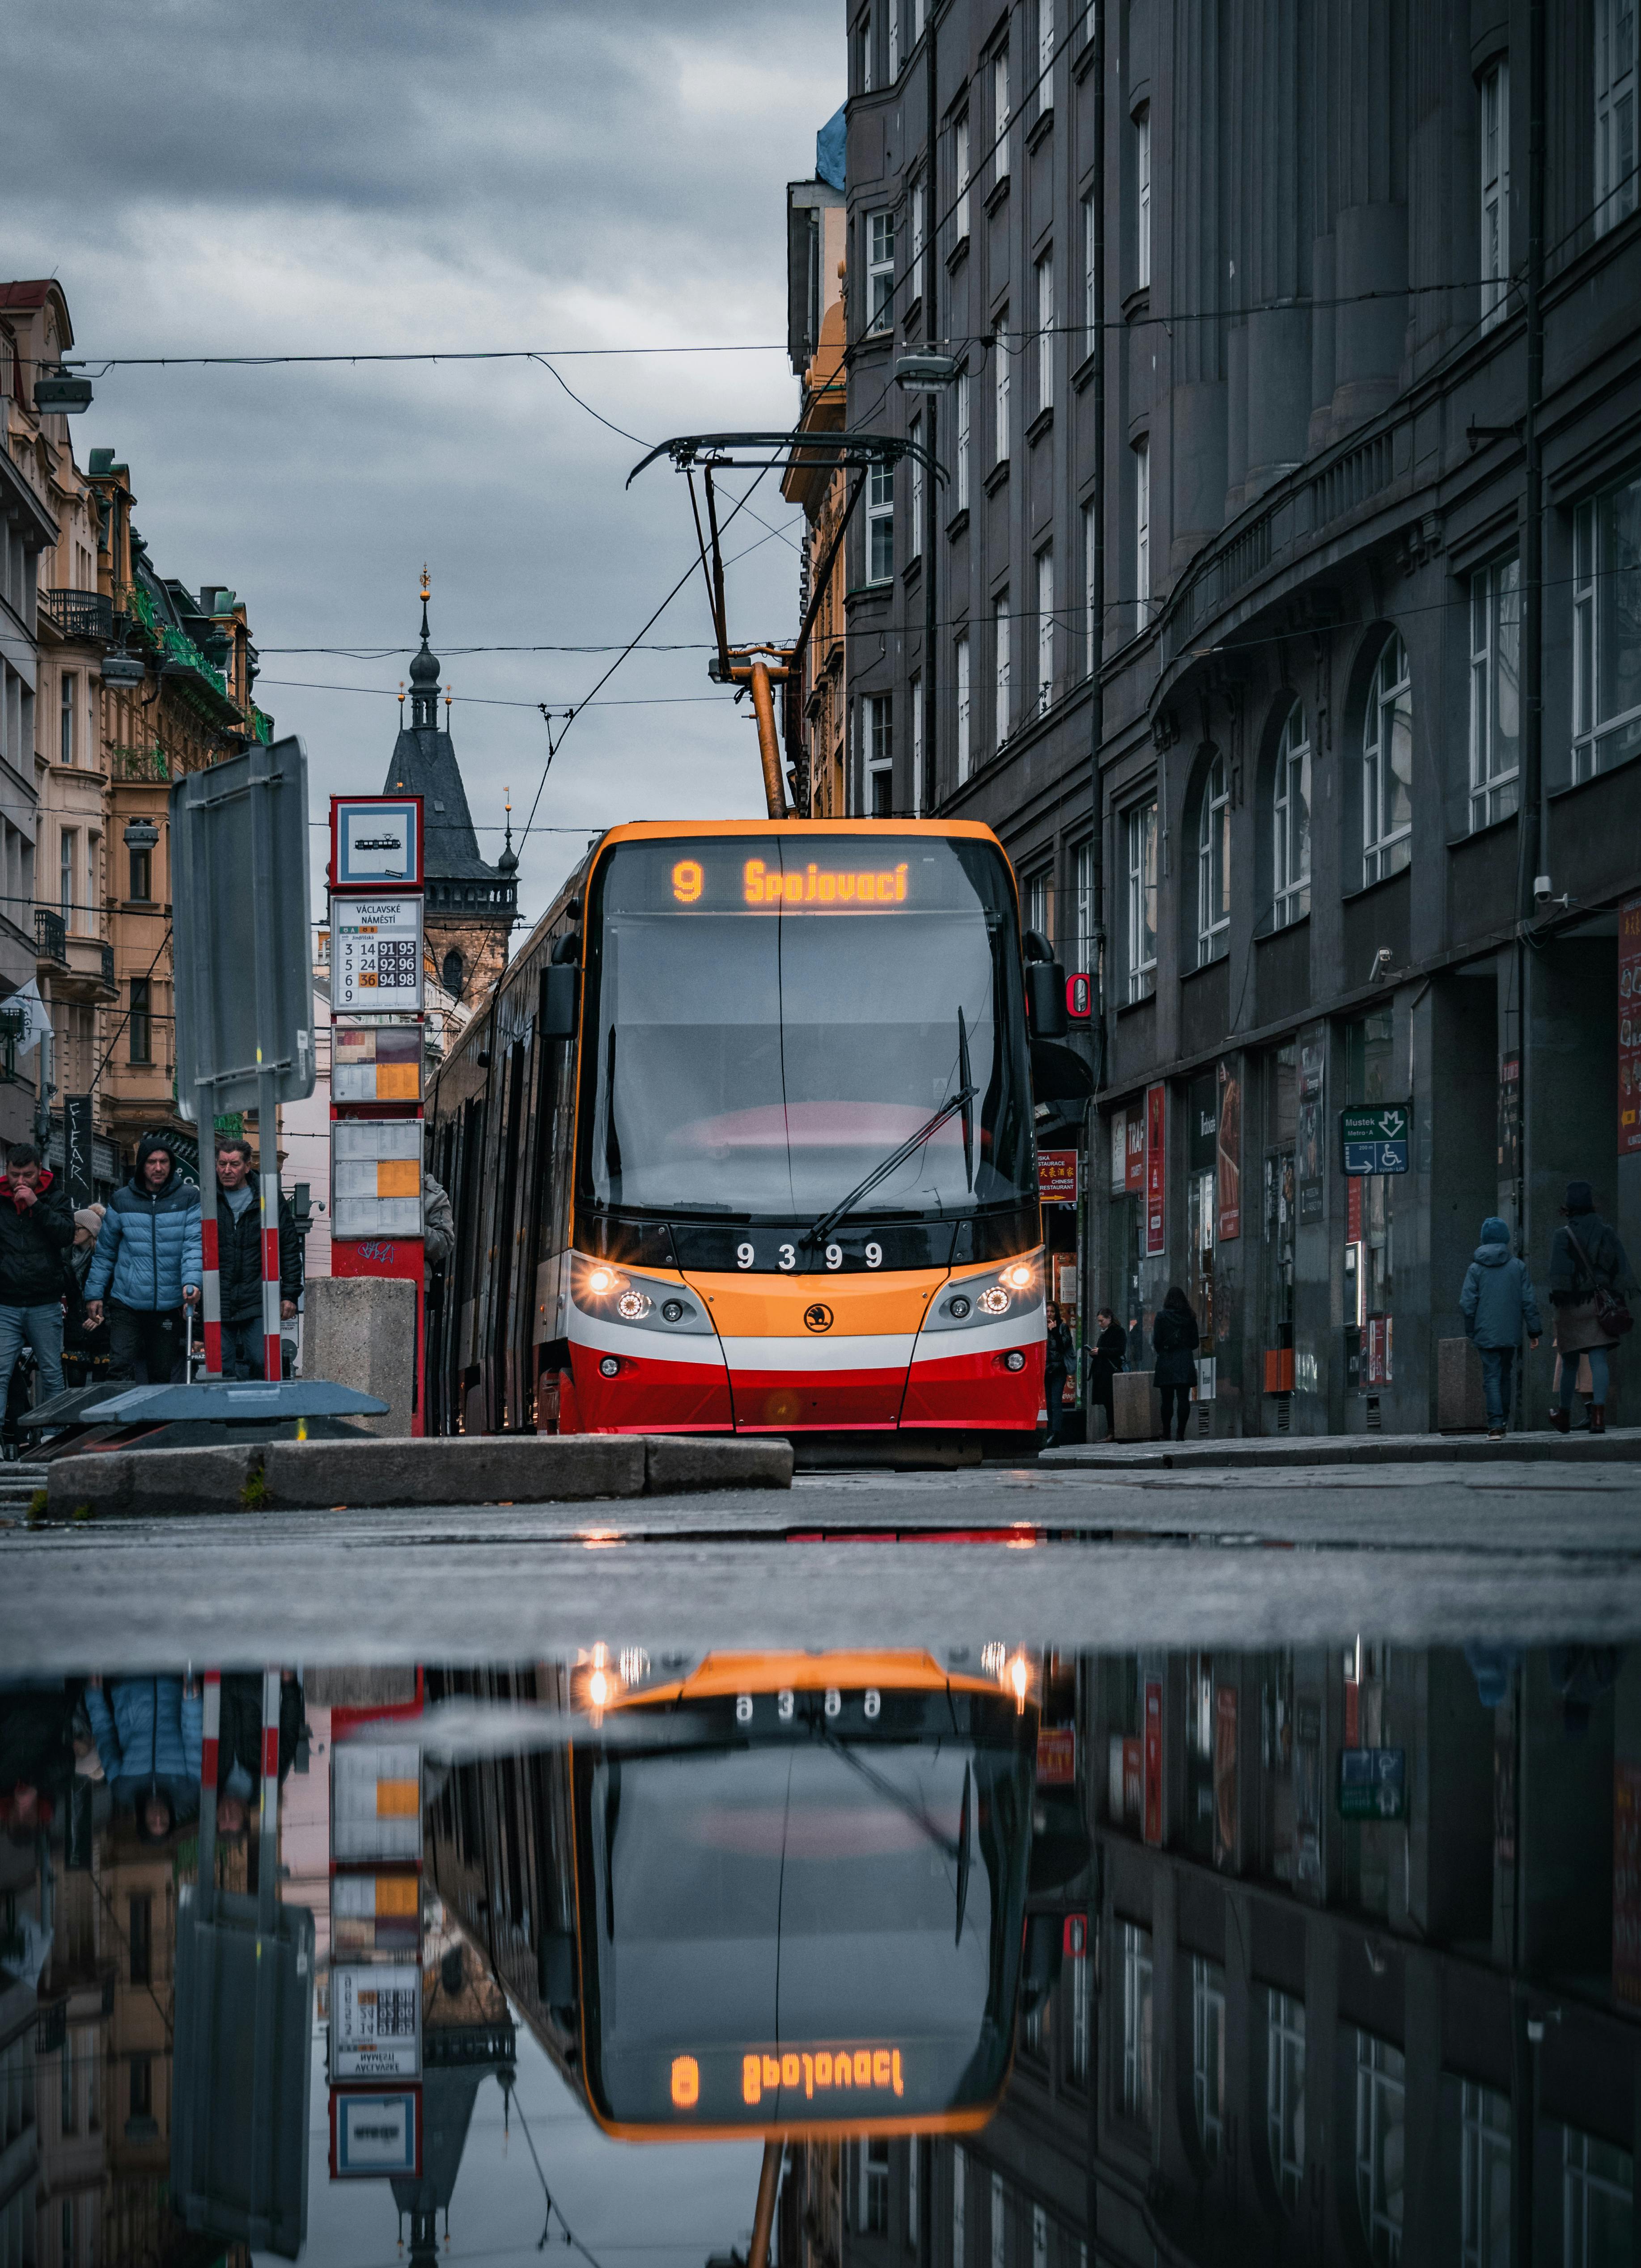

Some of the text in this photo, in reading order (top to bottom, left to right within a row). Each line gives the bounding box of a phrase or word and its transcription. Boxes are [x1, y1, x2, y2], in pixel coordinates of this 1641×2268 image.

[671, 859, 908, 903] 9 Spojovací
[356, 904, 401, 914] VÁCLAVSKÉ
[361, 915, 395, 924] NÁMĚSTÍ
[345, 943, 414, 955] 3 14 91 95
[345, 958, 414, 971] 5 24 92 96
[345, 974, 414, 986] 6 36 94 98
[345, 990, 352, 1002] 9
[737, 1243, 882, 1269] 9399
